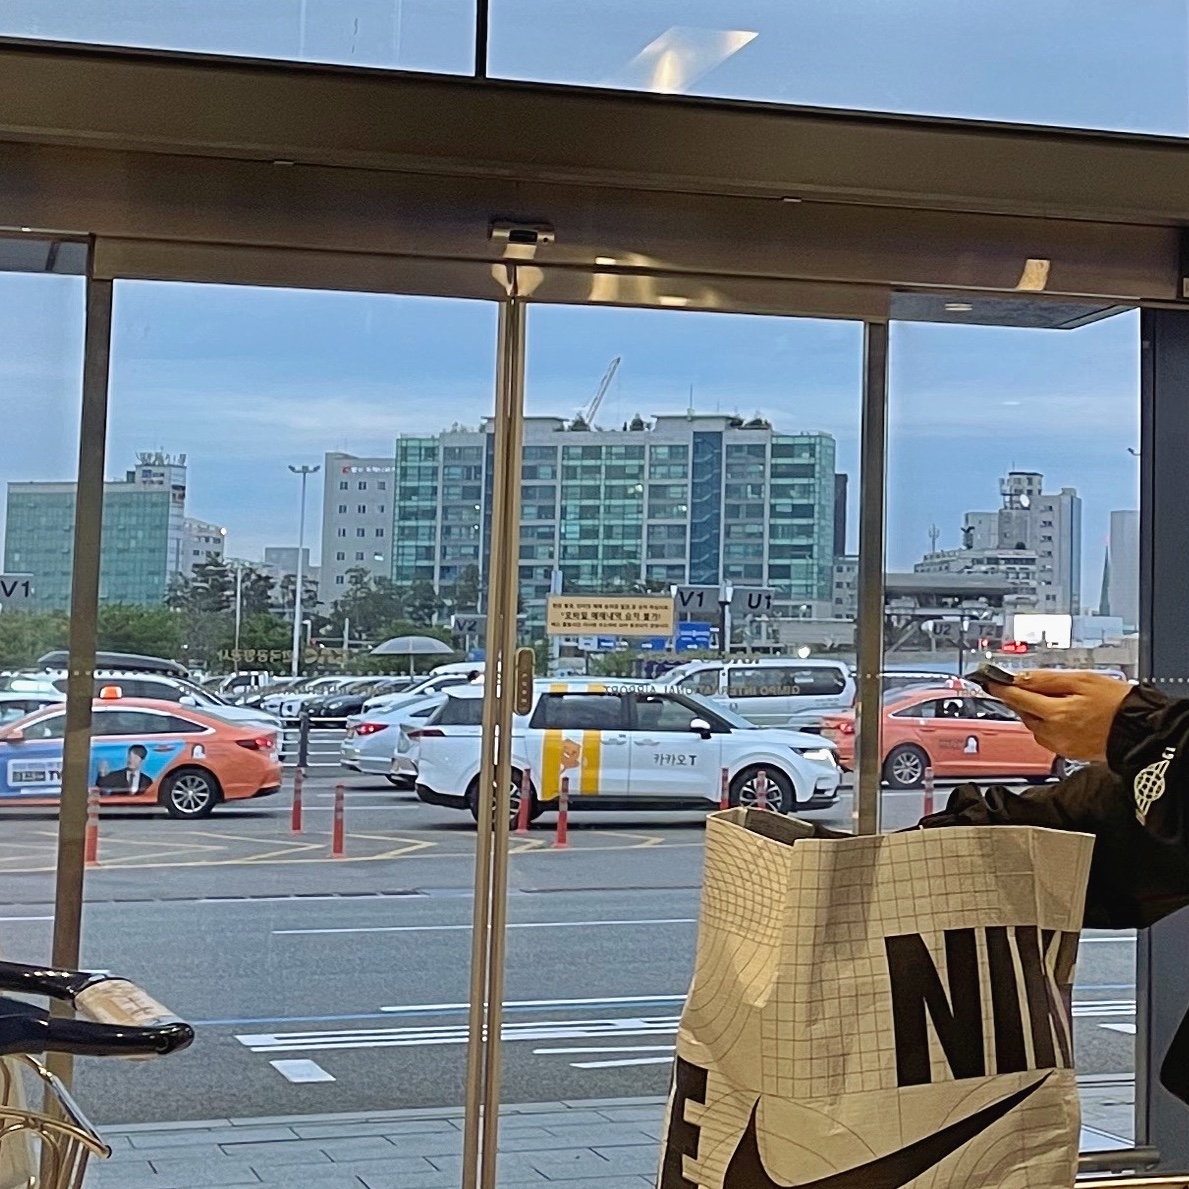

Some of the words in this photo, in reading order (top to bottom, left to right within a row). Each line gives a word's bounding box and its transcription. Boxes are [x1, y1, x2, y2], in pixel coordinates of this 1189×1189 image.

[1, 580, 30, 598] V1
[679, 591, 704, 607] V1
[748, 593, 772, 609] U1
[455, 619, 477, 632] V2
[933, 623, 952, 636] U2
[978, 625, 994, 636] T2
[653, 754, 688, 766] 카카오
[688, 755, 697, 766] T
